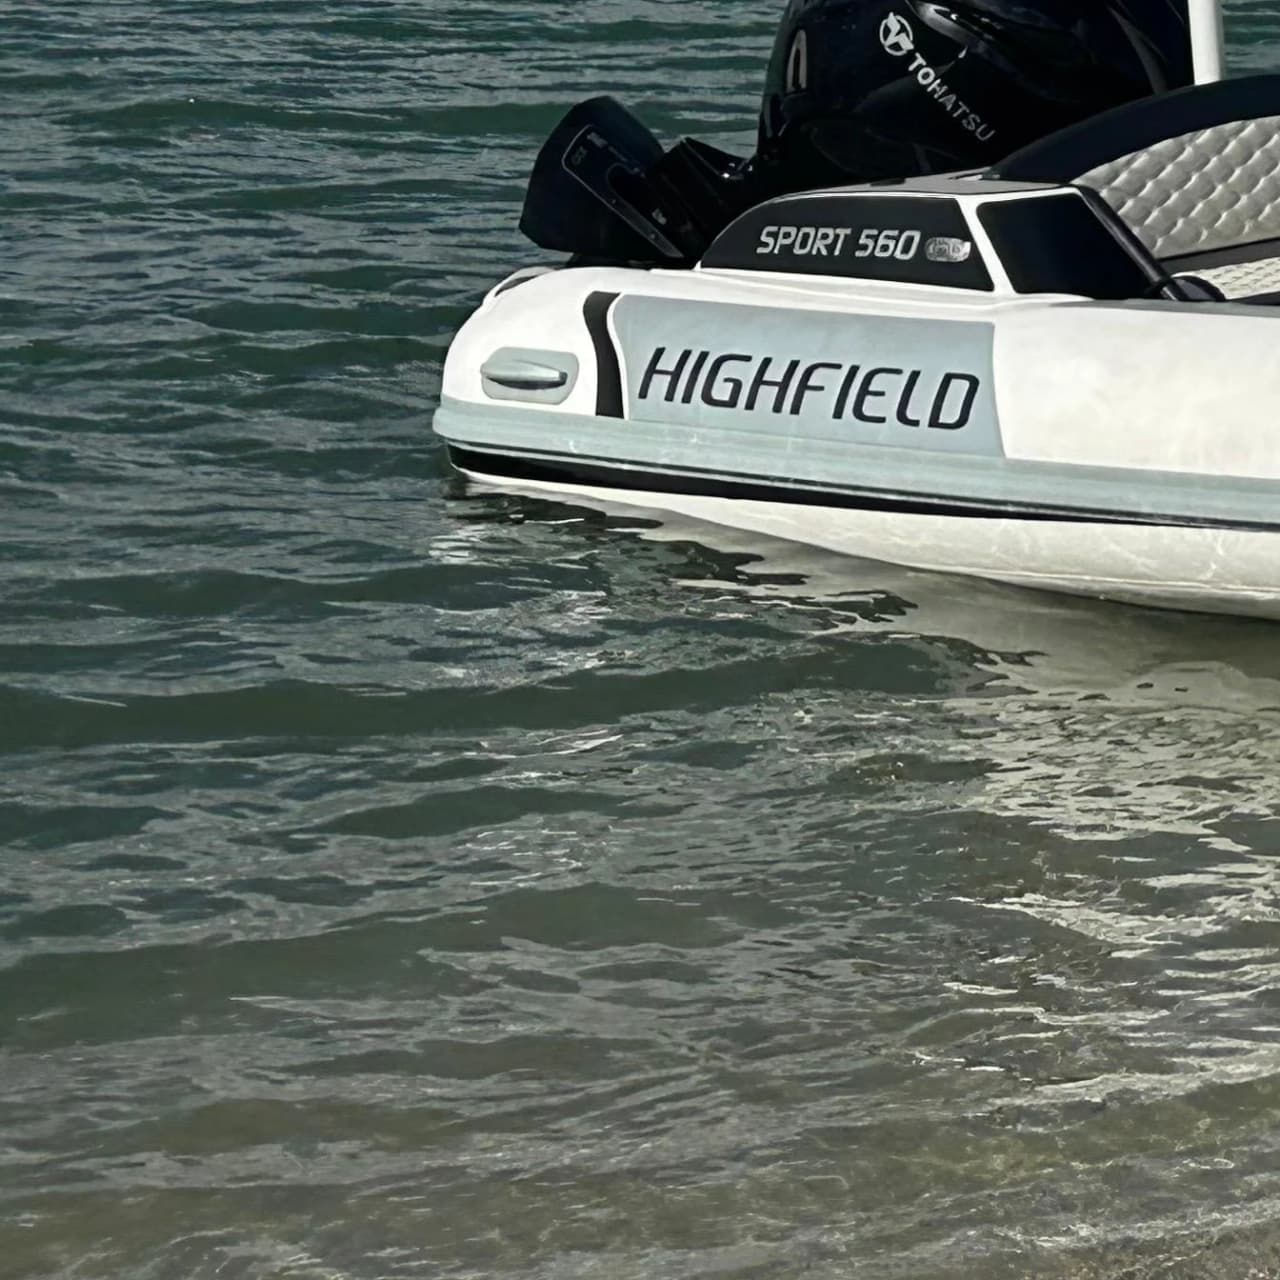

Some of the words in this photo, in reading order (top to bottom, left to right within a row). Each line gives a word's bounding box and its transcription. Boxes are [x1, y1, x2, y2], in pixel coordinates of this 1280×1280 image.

[908, 52, 995, 141] TOHATSU
[756, 225, 852, 256] SPORT
[854, 228, 921, 260] 560
[637, 346, 981, 431] HIGHFIELD
